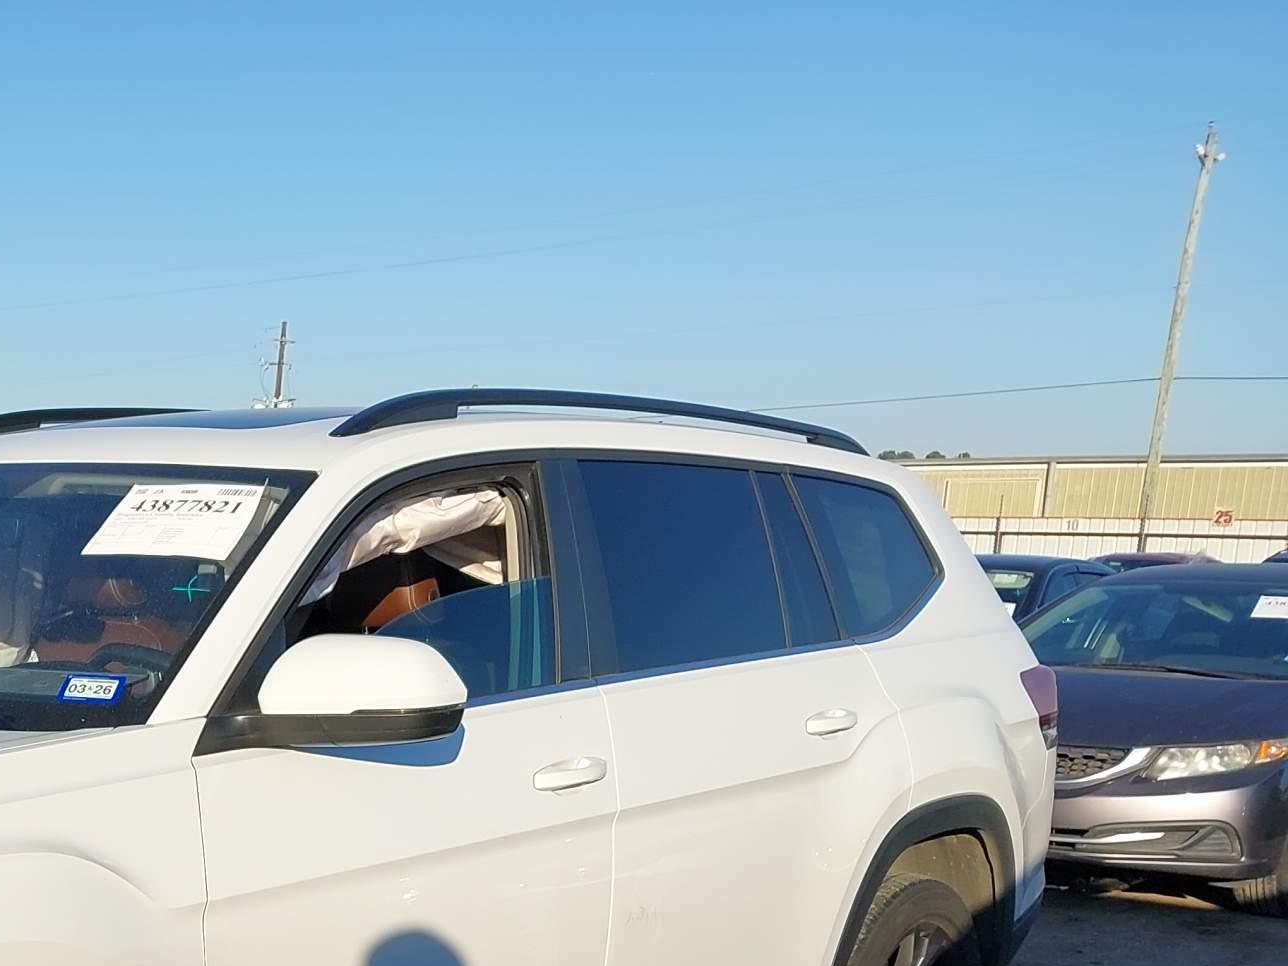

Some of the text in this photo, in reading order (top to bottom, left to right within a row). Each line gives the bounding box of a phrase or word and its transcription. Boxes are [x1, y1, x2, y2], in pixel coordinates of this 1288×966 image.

[130, 499, 243, 514] 43877821
[1214, 510, 1234, 524] 25
[1066, 519, 1079, 531] 10
